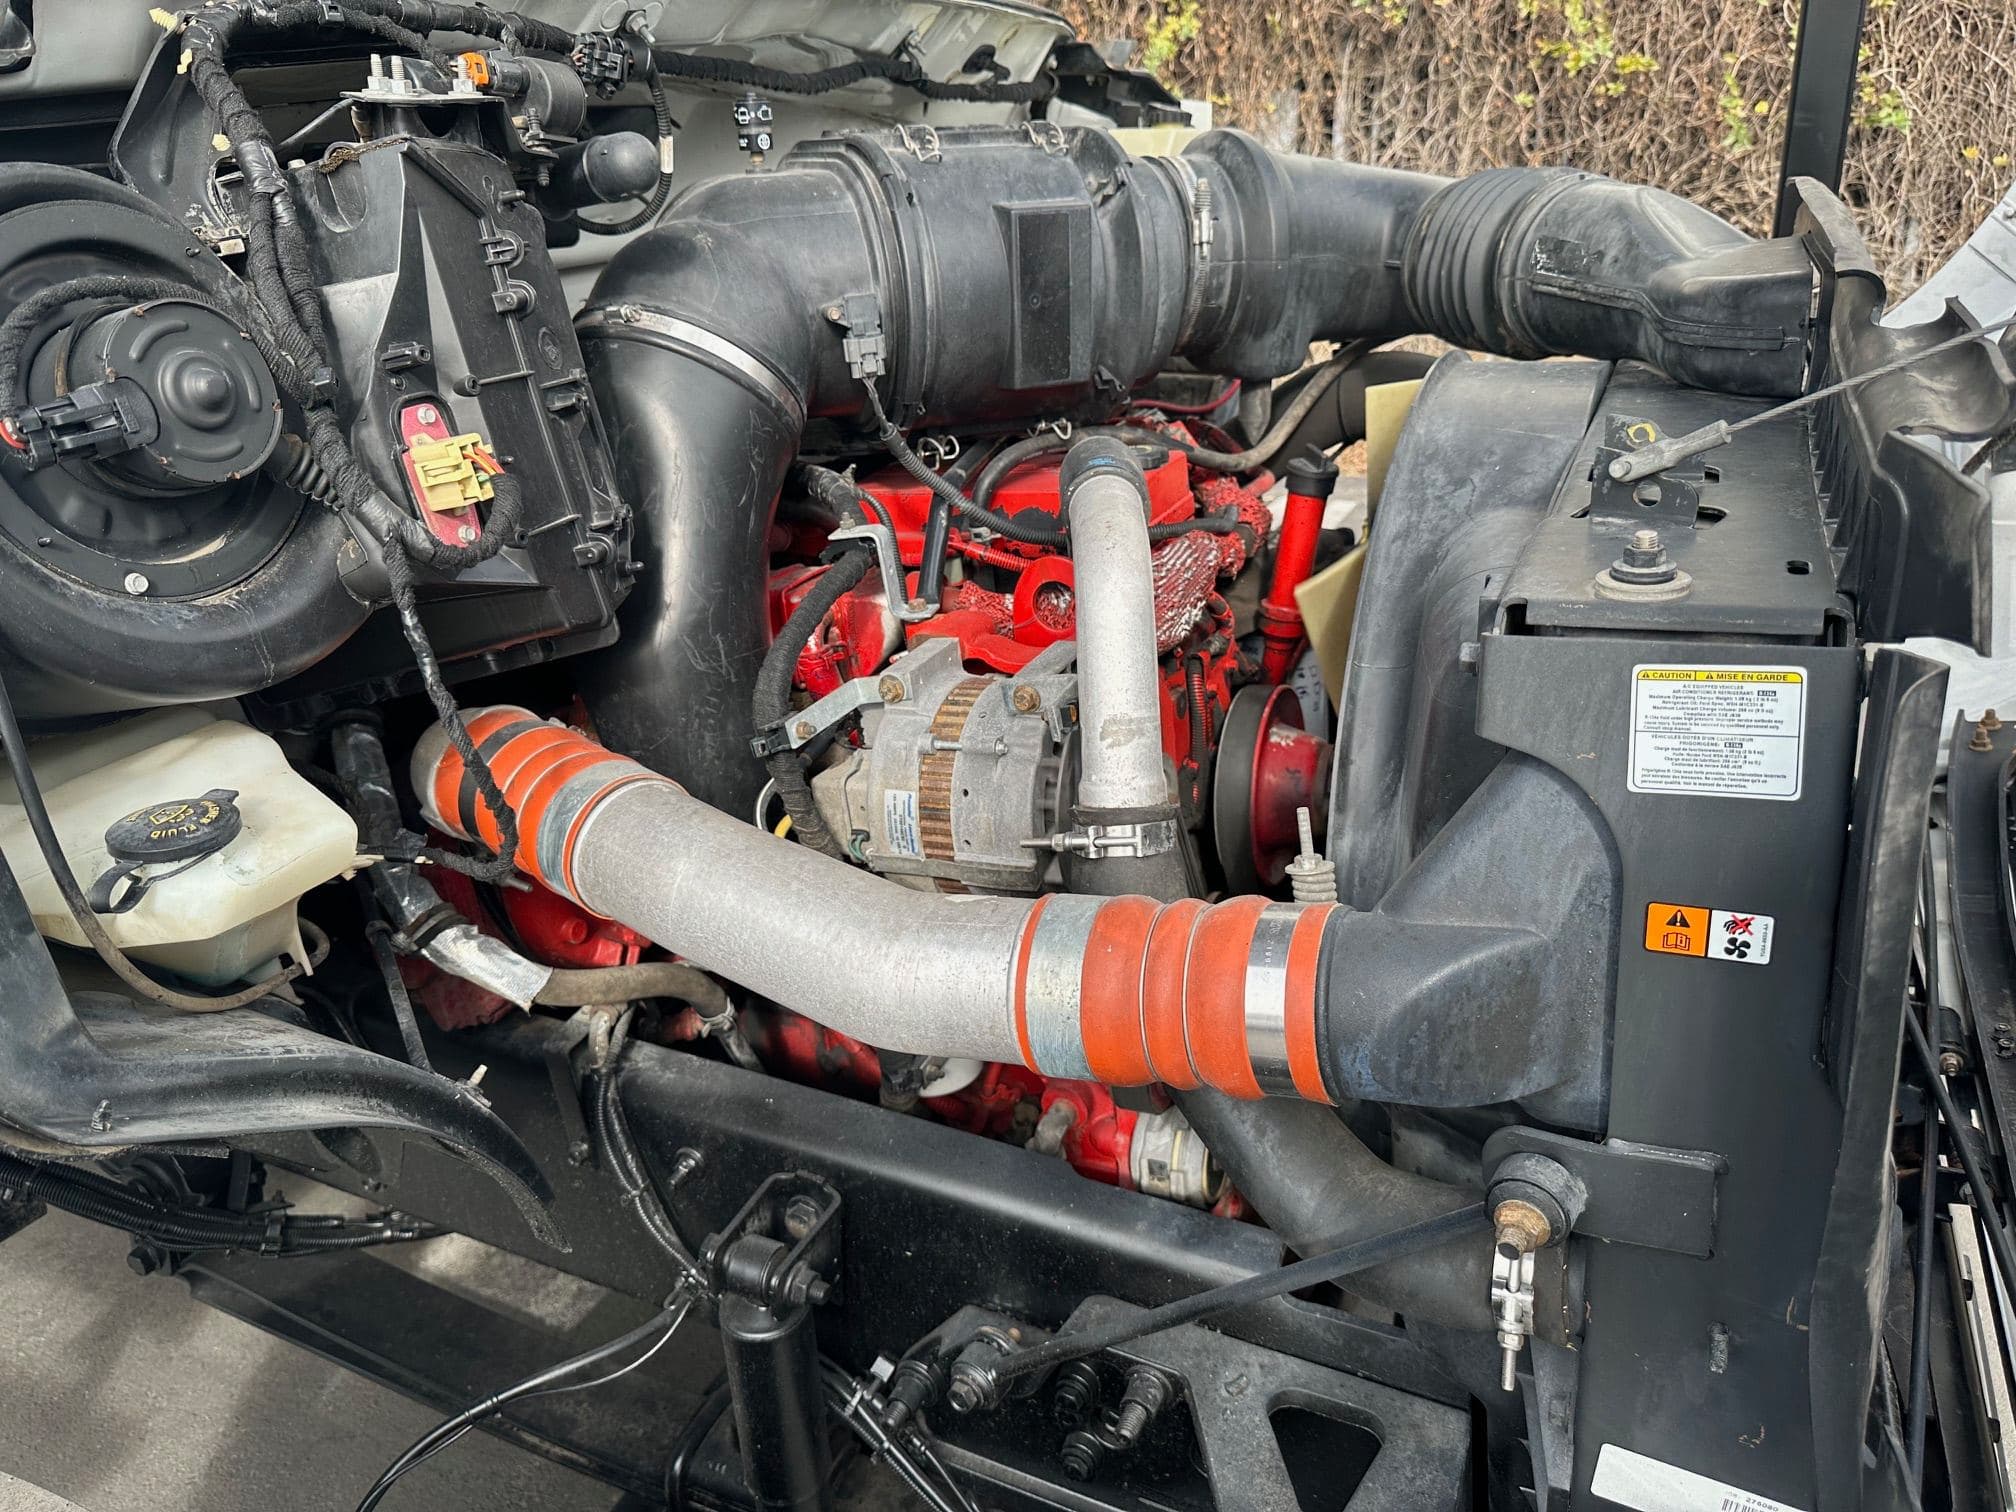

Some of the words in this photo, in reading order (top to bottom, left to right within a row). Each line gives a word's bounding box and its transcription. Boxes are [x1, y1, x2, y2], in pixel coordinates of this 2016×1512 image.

[1652, 672, 1692, 680] CAUTION
[1716, 673, 1739, 681] MISE
[1741, 673, 1753, 681] EN
[1756, 674, 1789, 682] GARDE
[150, 823, 198, 839] FLUID
